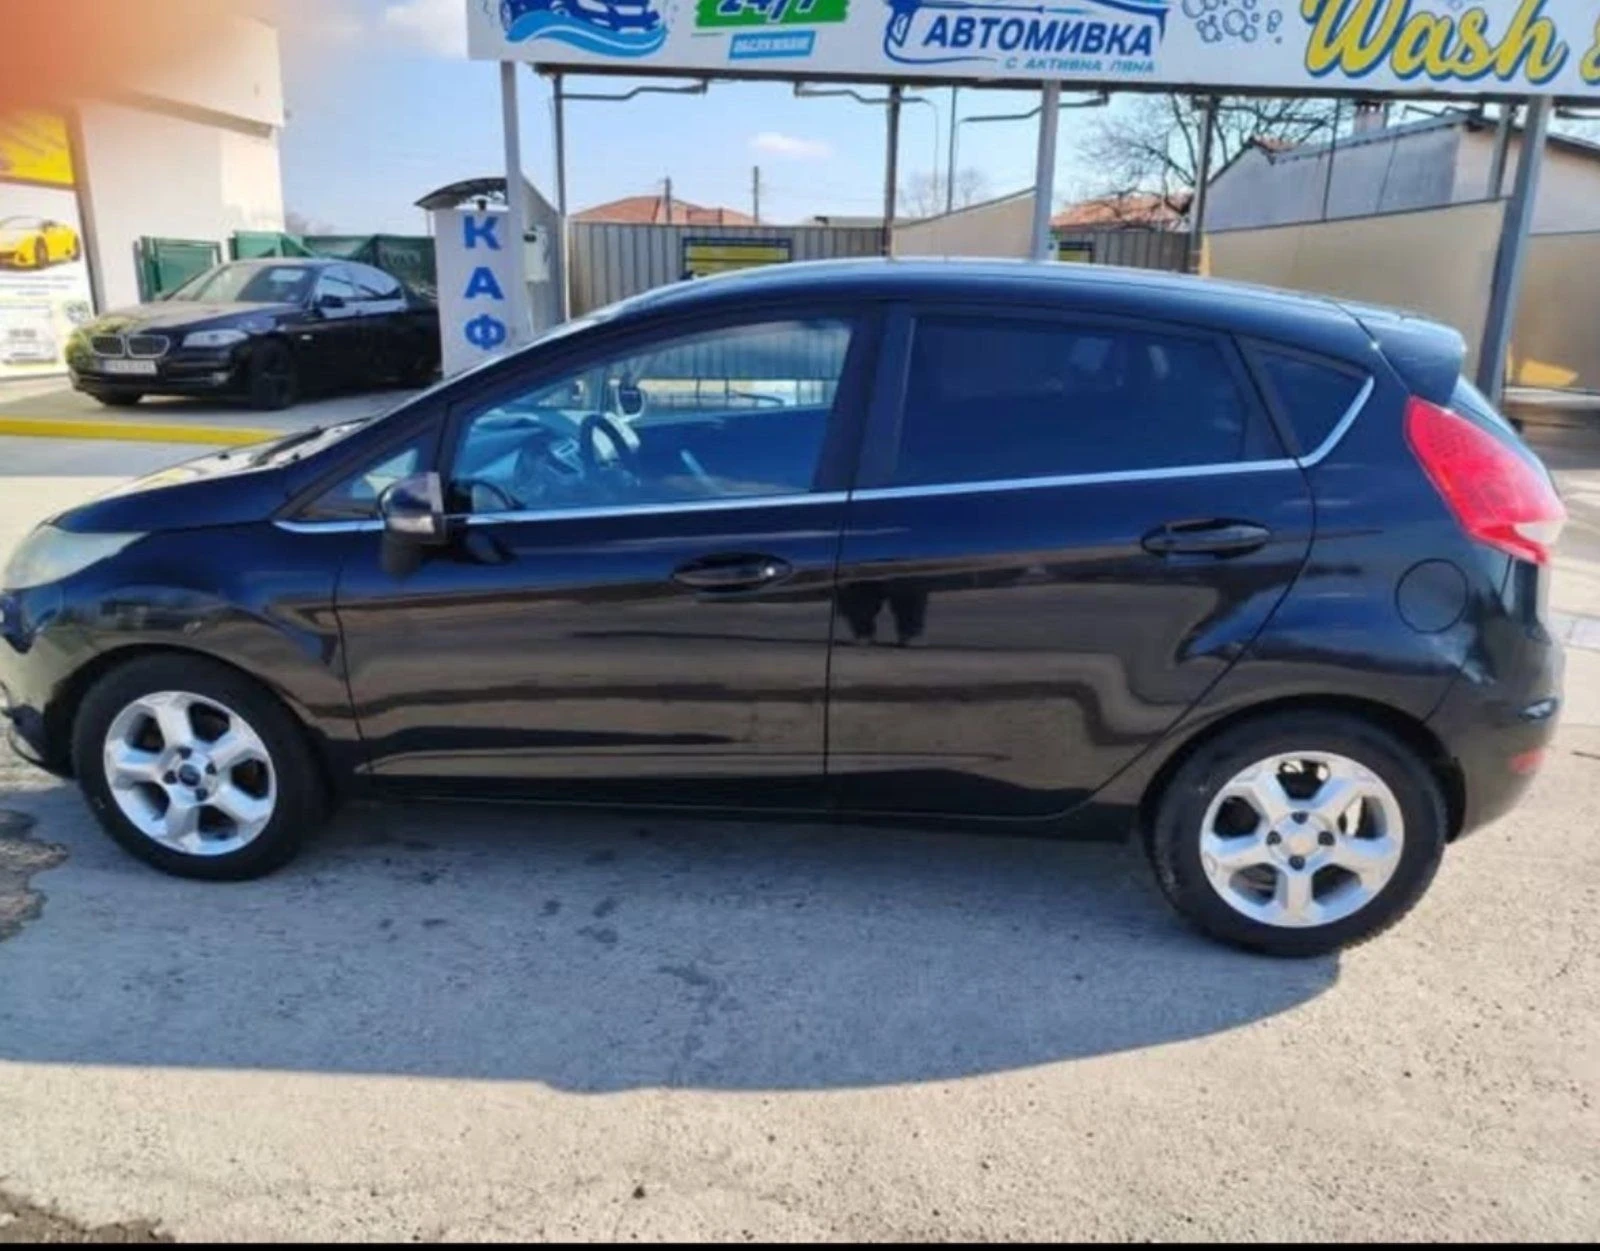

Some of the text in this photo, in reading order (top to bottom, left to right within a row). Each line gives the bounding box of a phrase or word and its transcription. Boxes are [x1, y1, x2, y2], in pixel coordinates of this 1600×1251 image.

[922, 15, 1153, 57] АВТОМИВКА
[1299, 0, 1570, 85] Wash
[1025, 58, 1103, 72] АКТИВНА
